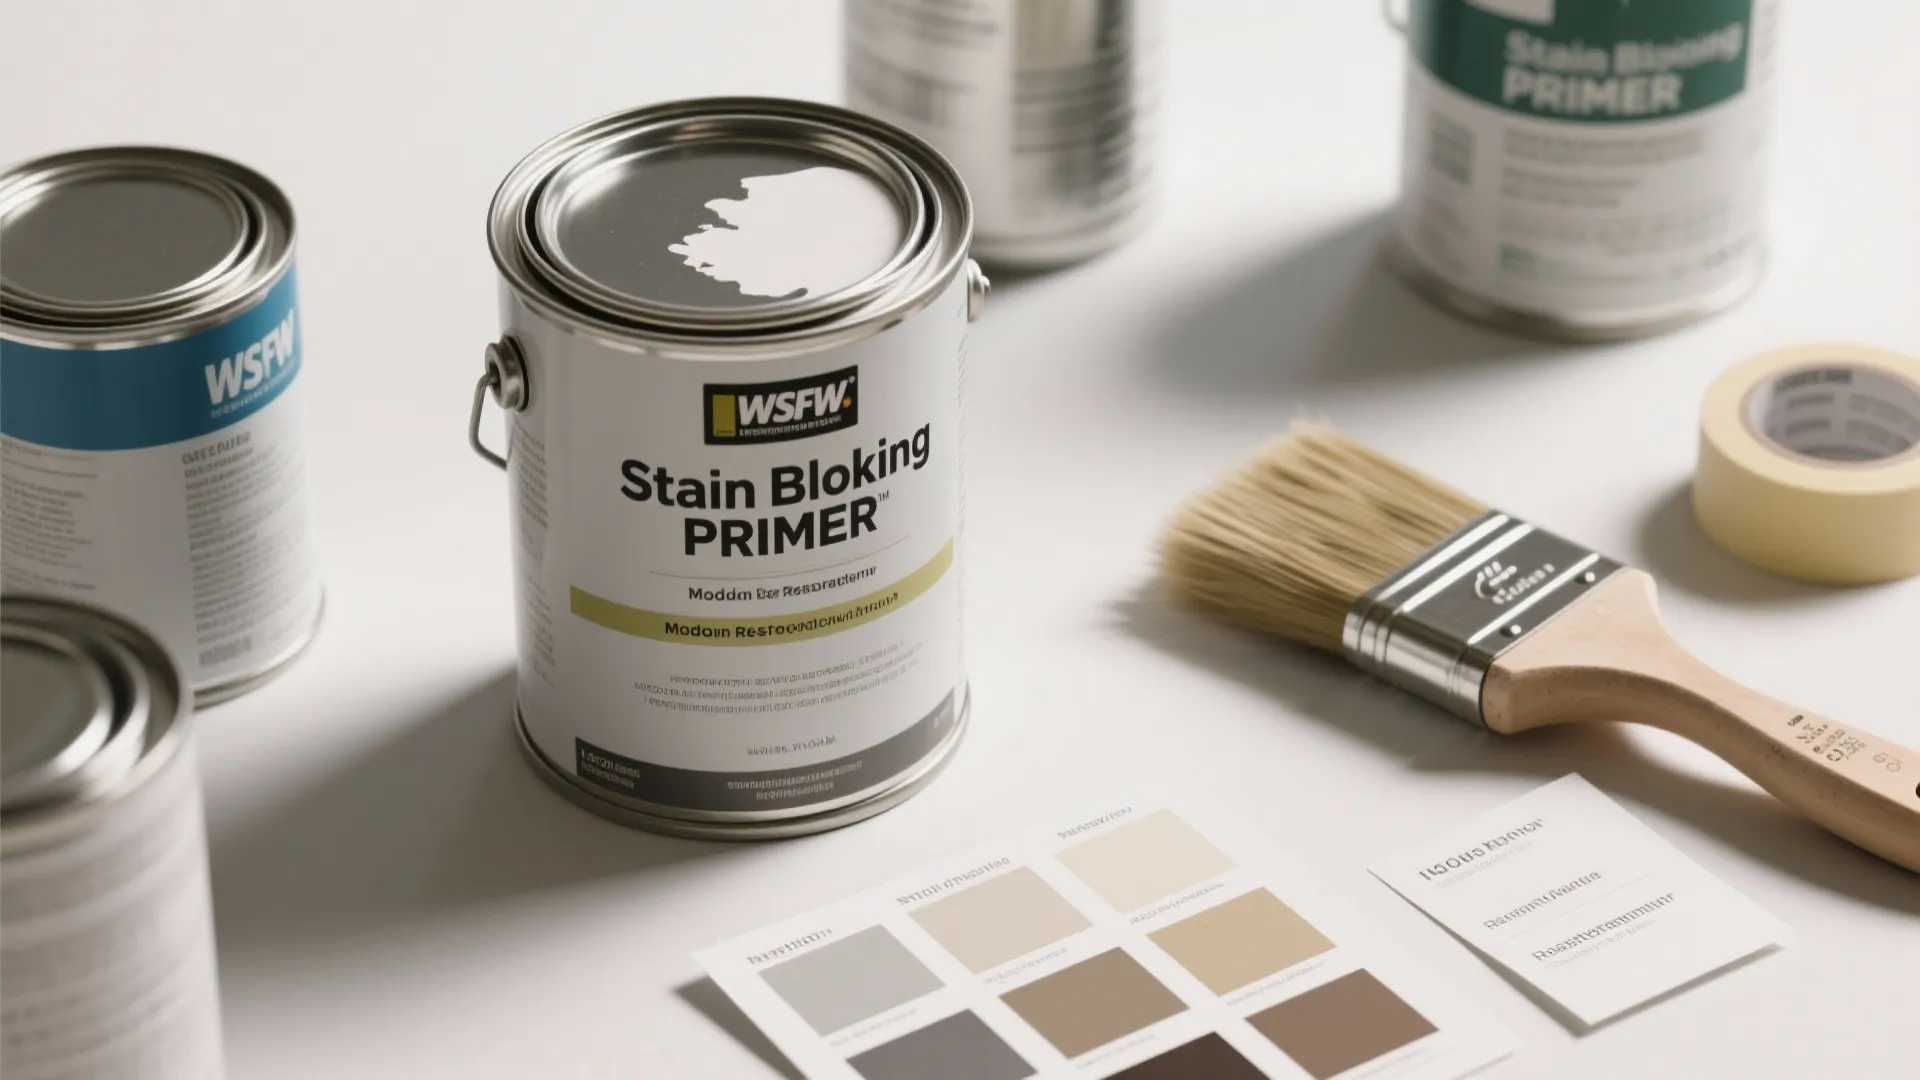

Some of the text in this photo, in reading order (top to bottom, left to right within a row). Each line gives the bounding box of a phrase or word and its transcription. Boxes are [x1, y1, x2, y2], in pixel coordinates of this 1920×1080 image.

[1502, 65, 1683, 115] PRIMER
[205, 309, 295, 404] WSFW
[620, 422, 930, 510] Stain Bloking
